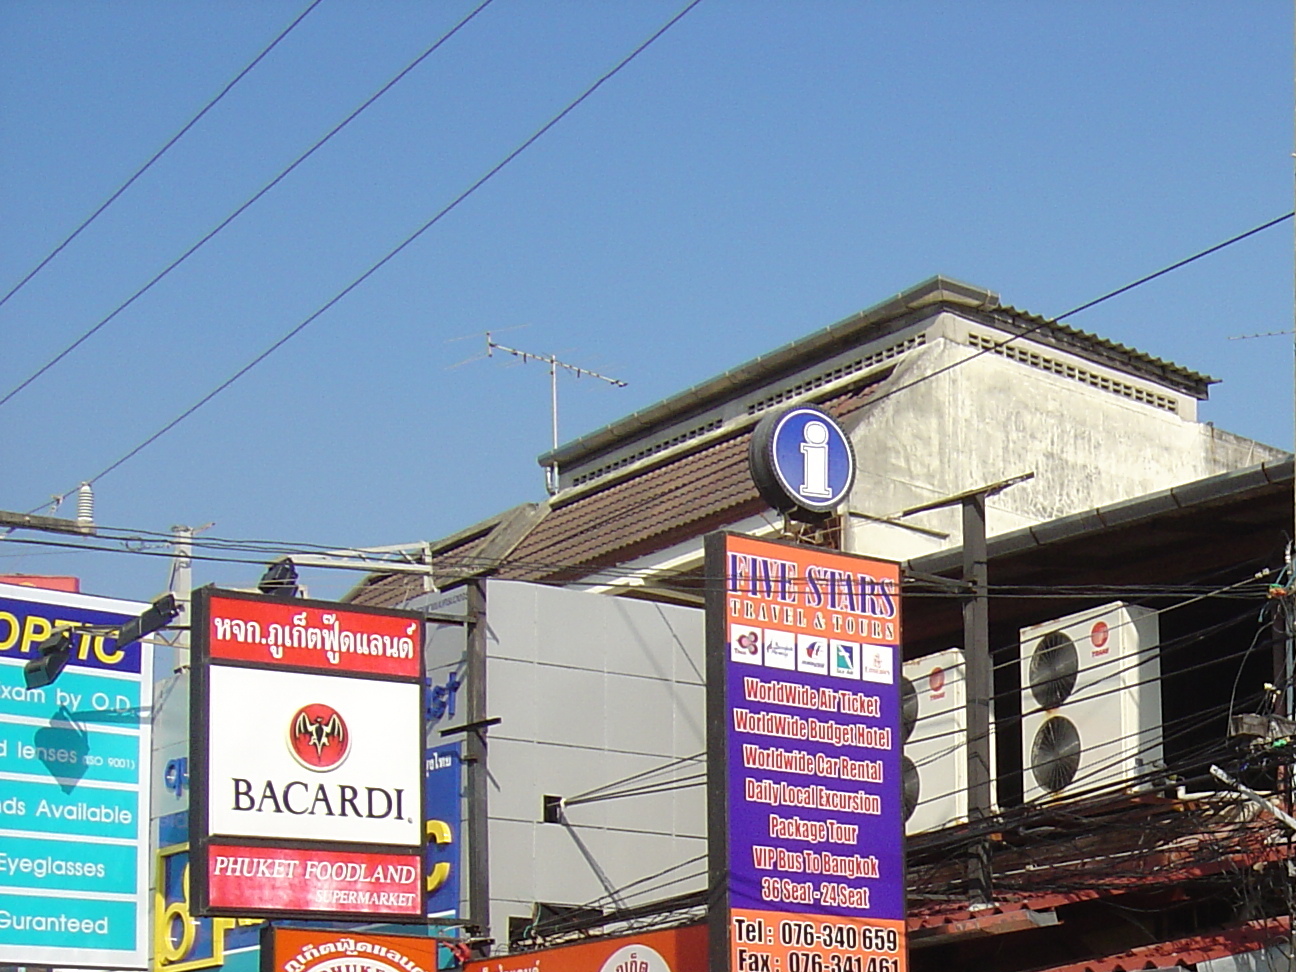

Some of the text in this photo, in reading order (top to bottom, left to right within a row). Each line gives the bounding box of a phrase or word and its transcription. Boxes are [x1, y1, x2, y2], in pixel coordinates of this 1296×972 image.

[728, 552, 895, 619] FIVE STARS
[730, 598, 894, 640] TRAVEL & TOURS
[56, 688, 82, 711] by
[744, 677, 880, 717] WorldWide Air Ticket
[733, 708, 892, 750] WorldWide Budget Hotel
[18, 742, 77, 763] lenses
[108, 758, 135, 770] 9001)
[743, 744, 883, 783] Worldwide Car Rental
[36, 799, 132, 823] Available
[231, 778, 405, 820] BACARDI
[745, 778, 881, 814] Daily Local Excursion
[769, 814, 858, 844] Package Tour
[214, 857, 415, 884] PHUKET FOODLAND
[753, 846, 879, 879] VIP Bus To Bangkok
[316, 889, 415, 907] SUPERMARKET
[761, 877, 870, 909] 36 Seat 24 Seat
[0, 911, 108, 935] Guranteed
[780, 920, 857, 949] 076-340
[862, 926, 898, 952] 659
